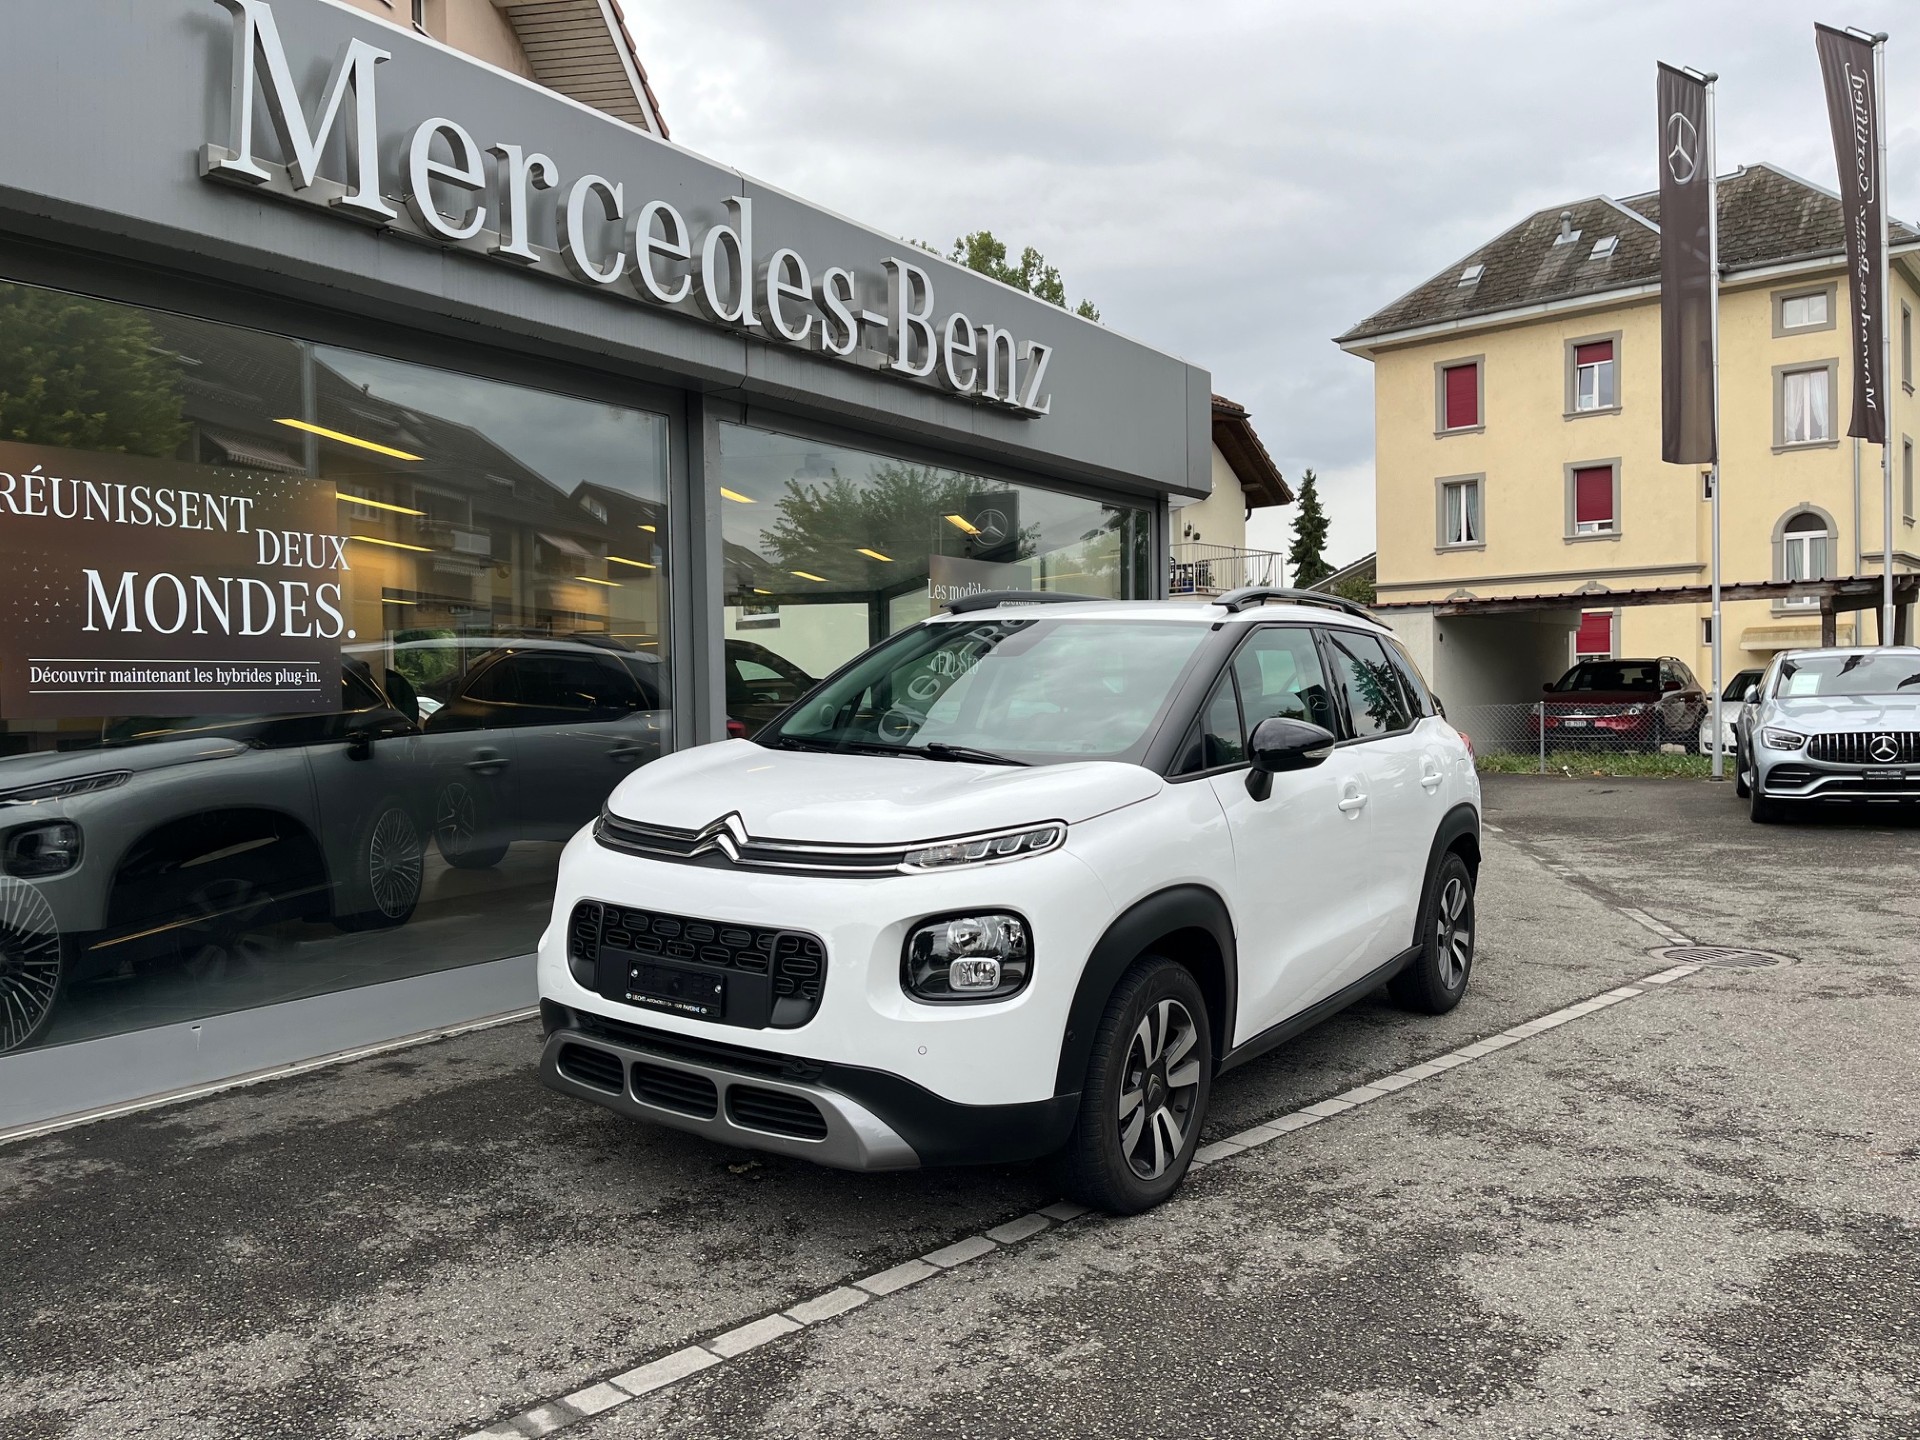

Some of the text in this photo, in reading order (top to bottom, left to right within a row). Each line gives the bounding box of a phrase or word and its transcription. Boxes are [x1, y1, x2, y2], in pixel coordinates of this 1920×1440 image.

[203, 0, 1054, 418] Mercedes-Benz
[0, 464, 254, 534] RÉUNISSENT
[255, 528, 351, 571] DEUX
[82, 568, 357, 639] MONDES.
[927, 578, 947, 600] Les
[949, 582, 993, 600] modèl
[29, 666, 322, 687] Découvrir maintenant les hybrides plug-in.
